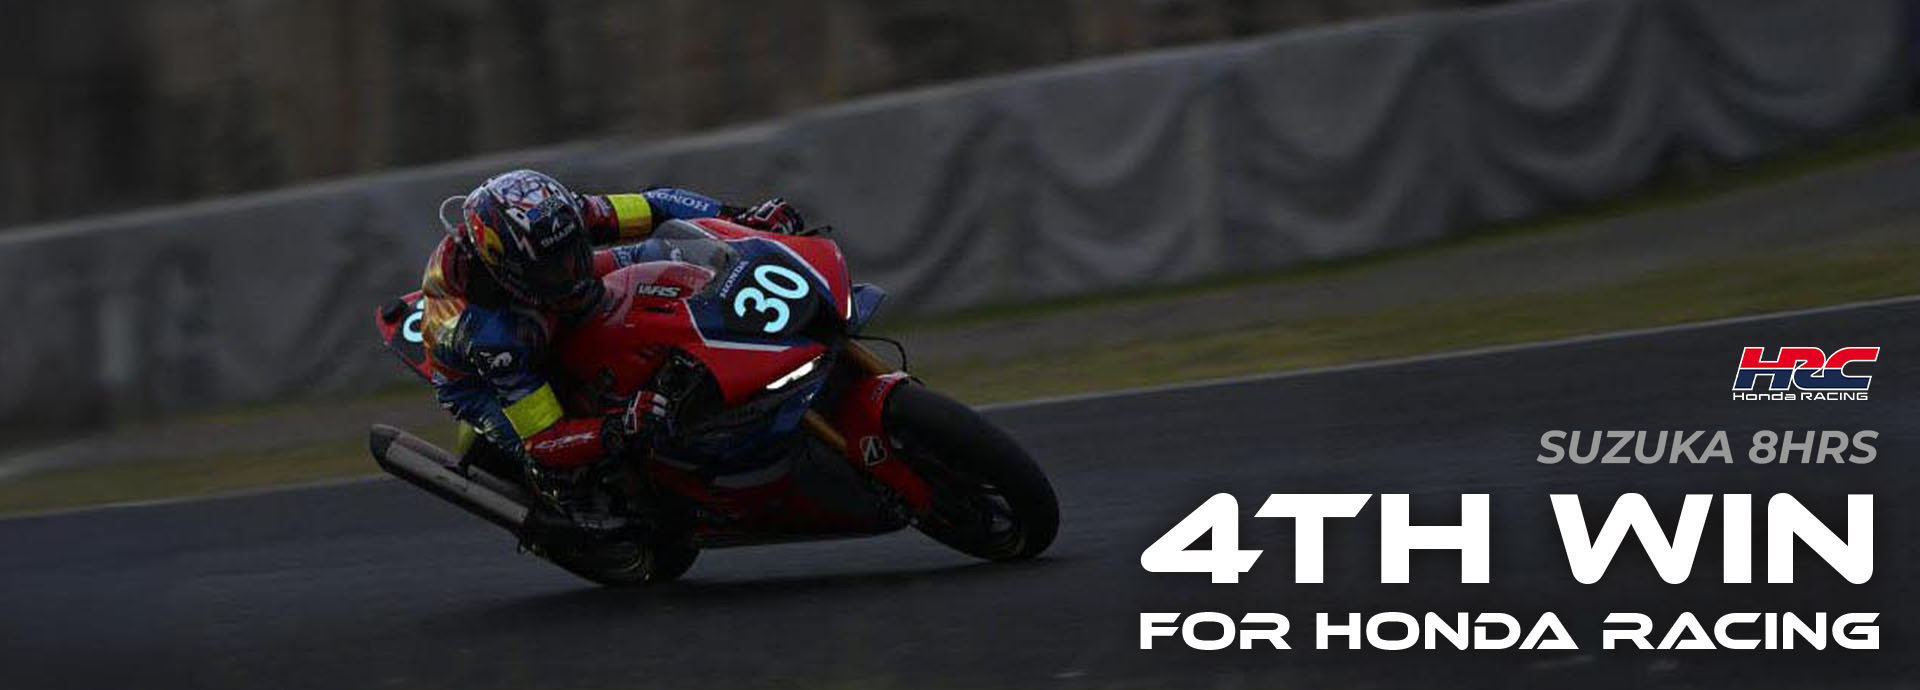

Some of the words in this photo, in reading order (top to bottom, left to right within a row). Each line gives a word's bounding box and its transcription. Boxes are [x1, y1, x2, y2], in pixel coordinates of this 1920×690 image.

[638, 284, 682, 298] WRS
[719, 259, 751, 299] HONDA
[734, 264, 811, 334] 30
